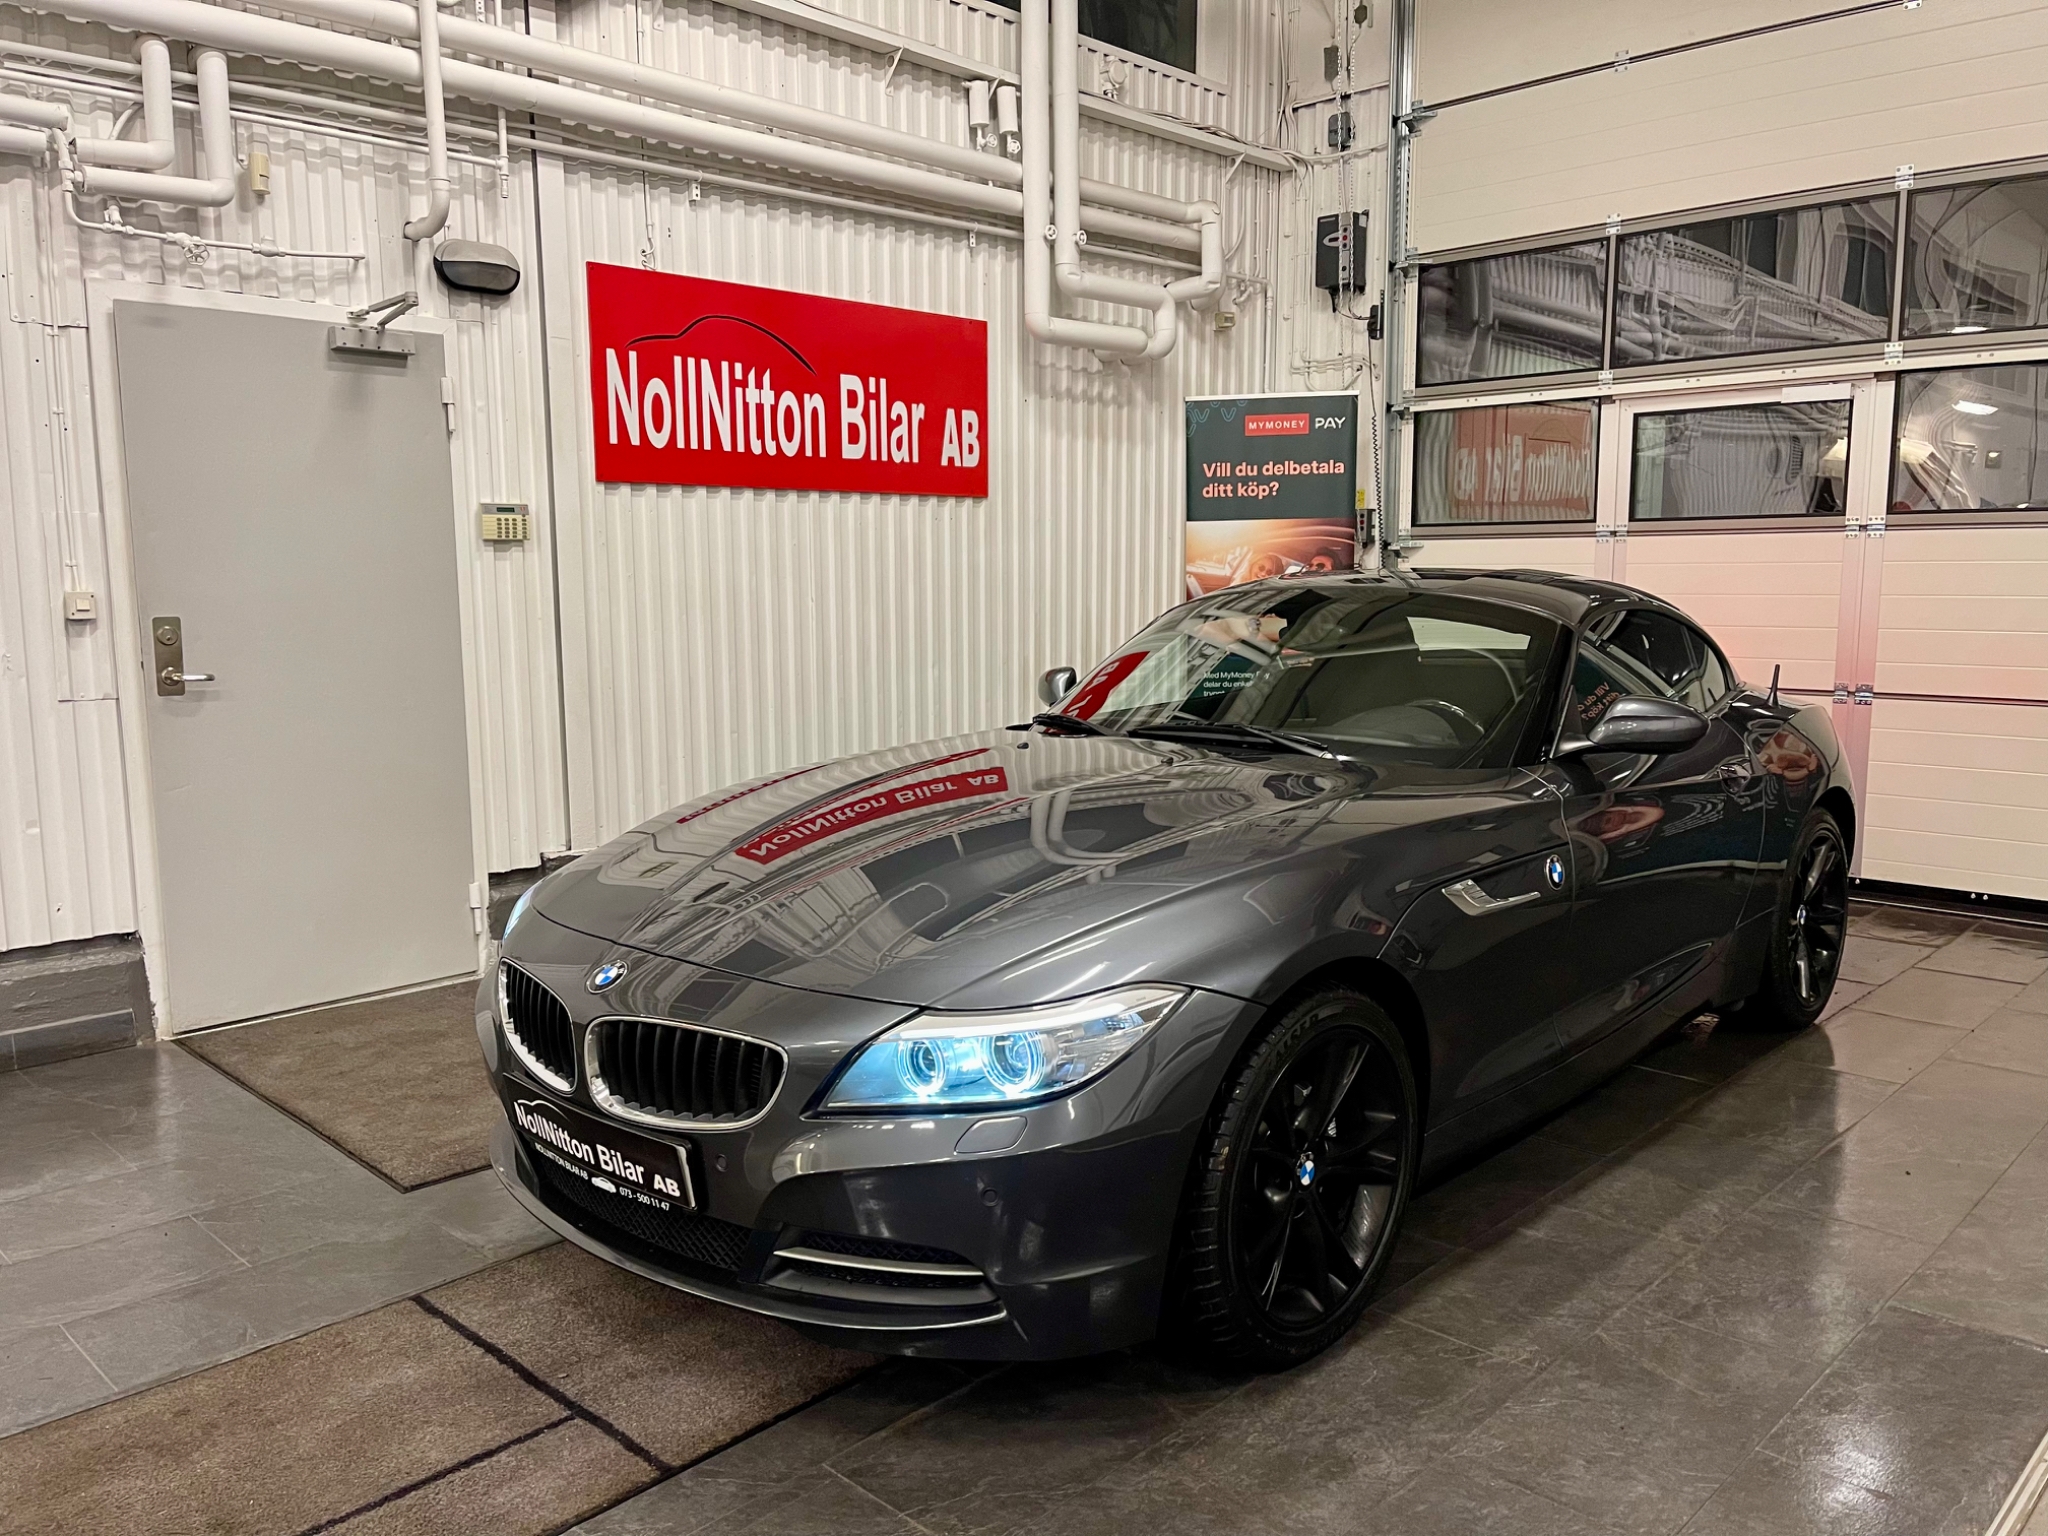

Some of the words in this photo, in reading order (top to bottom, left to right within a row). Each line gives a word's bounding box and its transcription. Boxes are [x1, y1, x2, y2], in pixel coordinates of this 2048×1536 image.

[606, 347, 827, 458] NollNitton
[839, 373, 926, 463] Bilar
[941, 407, 980, 468] AB
[1248, 420, 1306, 430] MYMONEY
[1315, 416, 1346, 430] PAY
[1203, 462, 1231, 478] Vill
[1235, 462, 1258, 477] du
[1262, 459, 1345, 476] delbetala
[1202, 482, 1233, 498] ditt
[1237, 481, 1280, 499] köp?
[1220, 671, 1255, 680] MyMoney
[513, 1101, 595, 1165] NollNitton
[596, 1143, 645, 1185] Bilar
[653, 1174, 681, 1197] AB
[619, 1186, 633, 1199] 073
[637, 1192, 650, 1205] 500
[651, 1198, 660, 1208] 11
